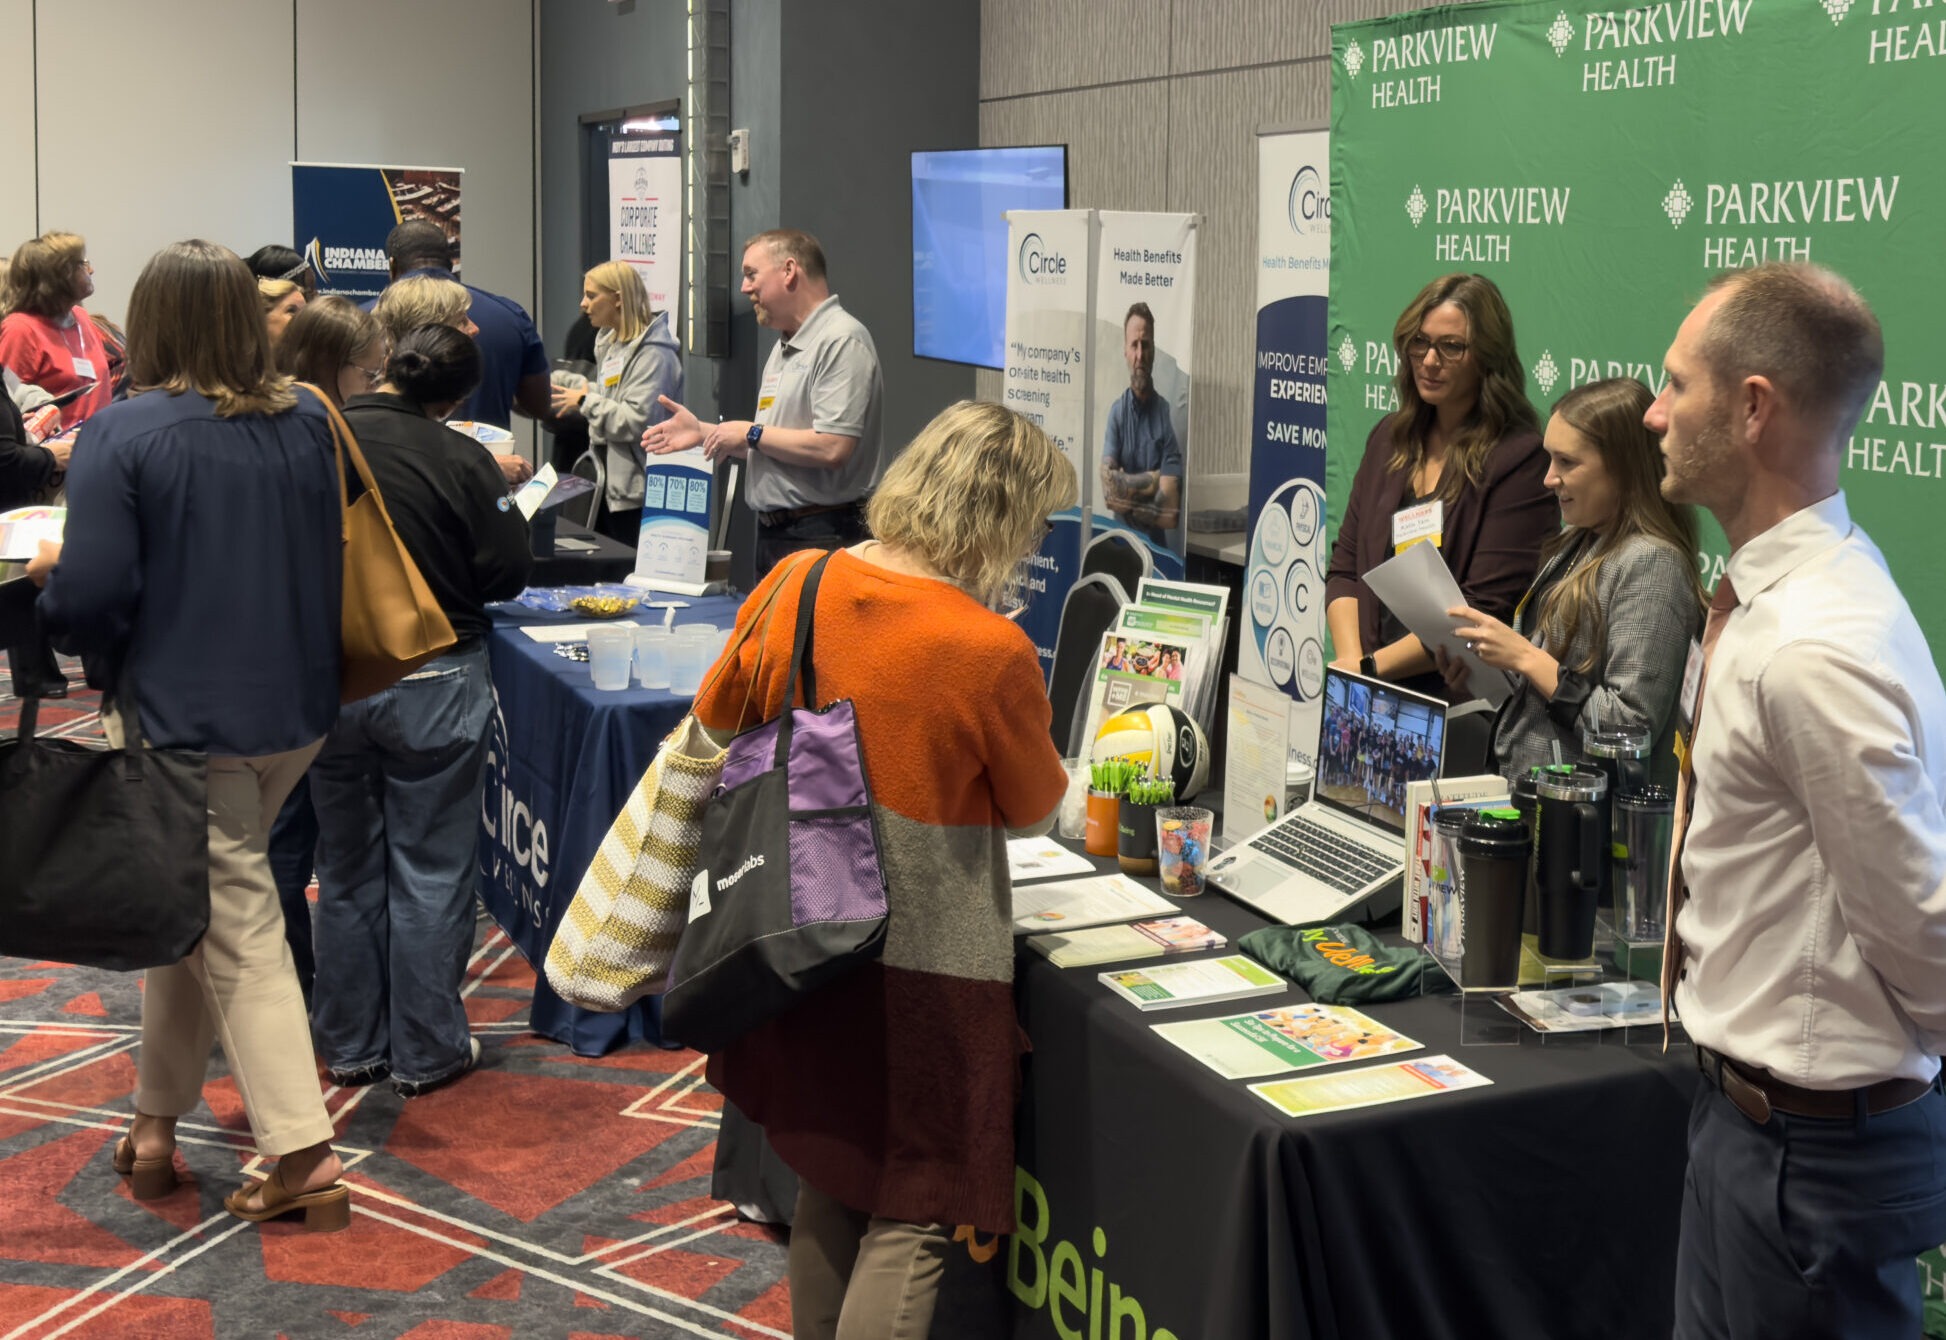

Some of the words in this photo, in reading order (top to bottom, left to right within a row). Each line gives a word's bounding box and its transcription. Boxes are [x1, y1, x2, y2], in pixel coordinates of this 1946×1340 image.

[1583, 0, 1753, 51] PARKVIEW
[1372, 23, 1498, 72] PARKVIEW
[1582, 54, 1677, 92] HEALTH
[1371, 75, 1442, 109] HEALTH
[1436, 187, 1571, 225] PARKVIEW
[1705, 175, 1901, 225] PARKVIEW
[620, 206, 658, 228] CORPORATE
[324, 247, 386, 260] INDIANA
[620, 233, 657, 255] CHALLENGE
[1436, 235, 1511, 262] HEALTH
[324, 258, 390, 271] CHAMBER
[1029, 251, 1067, 274] Circle
[1114, 248, 1141, 262] Health
[1143, 250, 1182, 264] Benefits
[1263, 257, 1286, 269] Health
[1288, 257, 1321, 270] Benefits
[1120, 271, 1143, 286] Made
[1145, 272, 1174, 288] Better
[1258, 352, 1306, 374] IMPROVE
[1041, 368, 1071, 384] health
[1008, 388, 1050, 408] screening
[1267, 421, 1300, 445] SAVE
[648, 476, 665, 489] 80%
[669, 478, 685, 491] 70%
[690, 480, 707, 493] 80%
[1030, 578, 1046, 593] and
[1007, 1165, 1179, 1340] Bein
